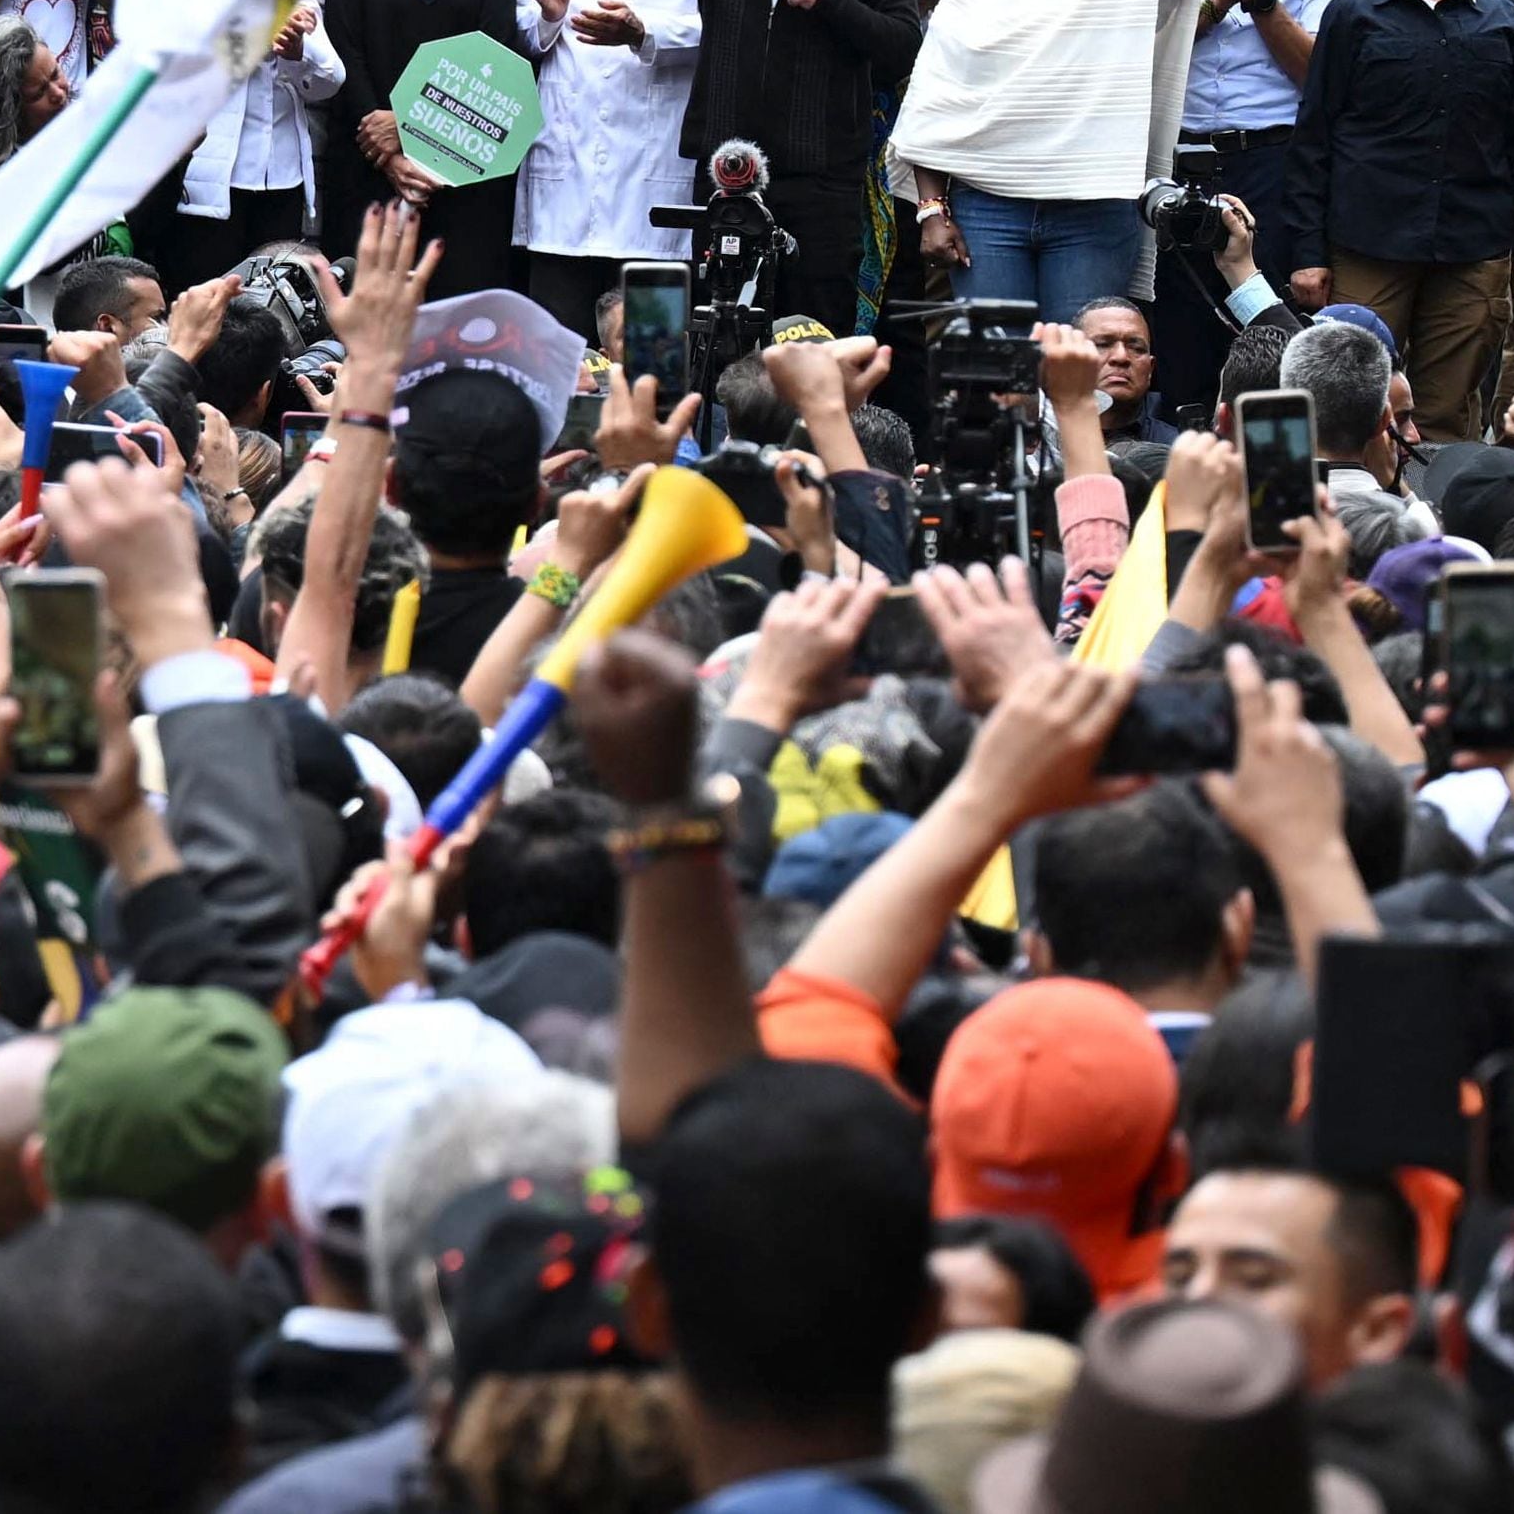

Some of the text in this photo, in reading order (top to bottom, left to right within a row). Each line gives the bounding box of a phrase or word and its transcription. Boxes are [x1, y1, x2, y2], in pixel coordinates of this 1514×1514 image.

[425, 87, 502, 139] DE NUESTROS
[429, 72, 514, 130] A LA ALTURA
[437, 57, 523, 117] POR UN PAÍS
[726, 237, 737, 245] AP
